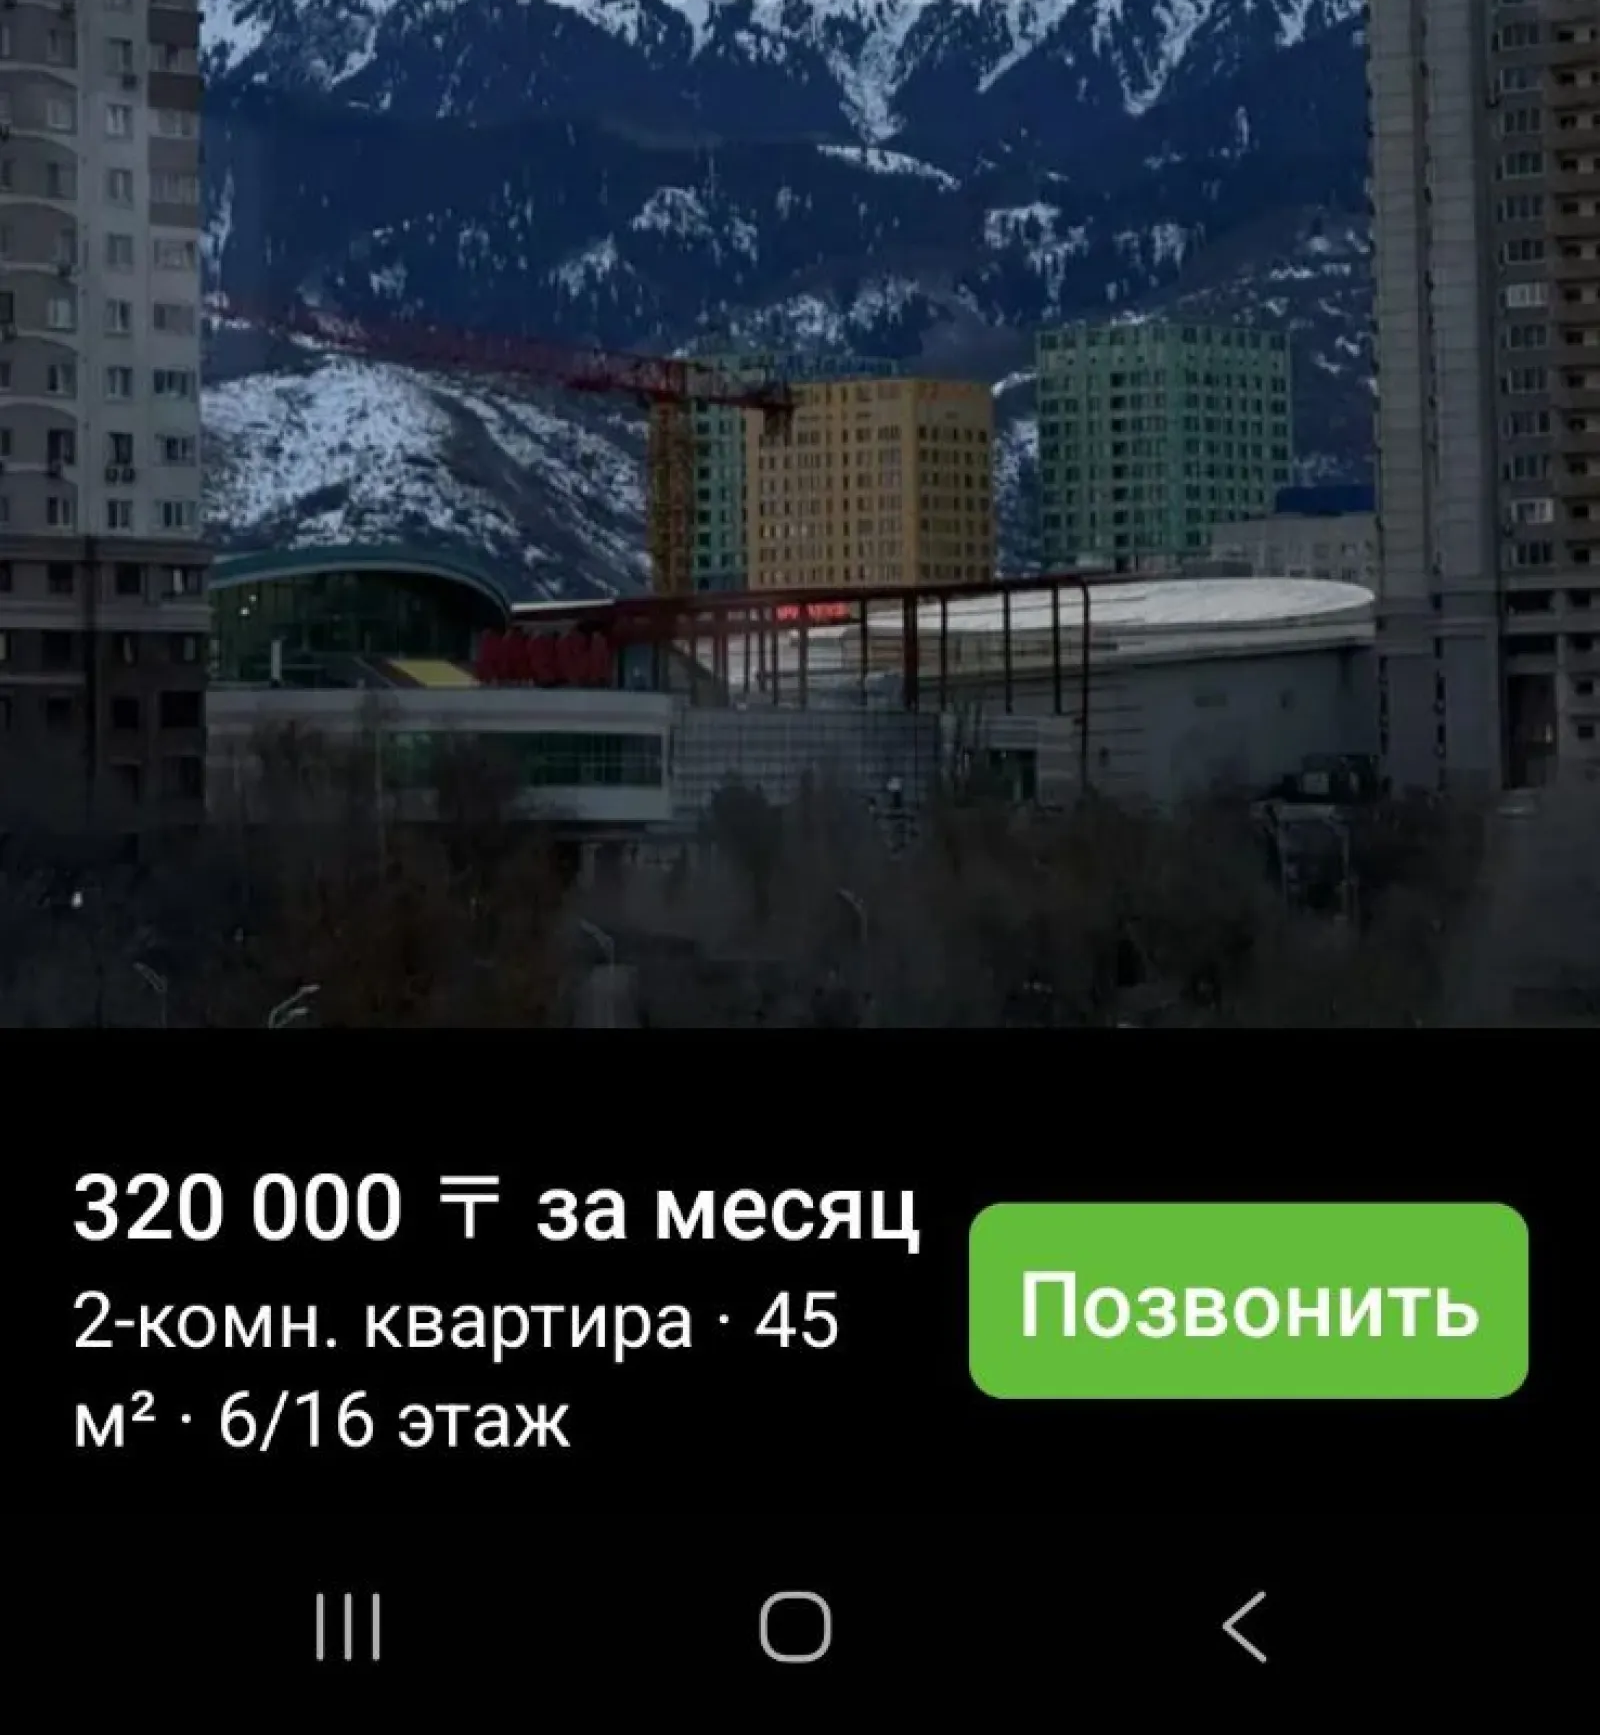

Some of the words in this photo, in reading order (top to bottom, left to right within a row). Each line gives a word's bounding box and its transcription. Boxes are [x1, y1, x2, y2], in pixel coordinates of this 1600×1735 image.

[73, 1172, 223, 1242] 320
[253, 1172, 400, 1242] 000
[537, 1188, 627, 1242] за
[656, 1188, 920, 1255] месяц
[73, 1290, 337, 1348] 2-комн.
[366, 1304, 693, 1363] квартира
[755, 1290, 838, 1348] 45
[1023, 1270, 1479, 1339] Позвонить
[75, 1389, 157, 1448] м²
[220, 1389, 374, 1452] 6/16
[398, 1403, 571, 1448] этаж
